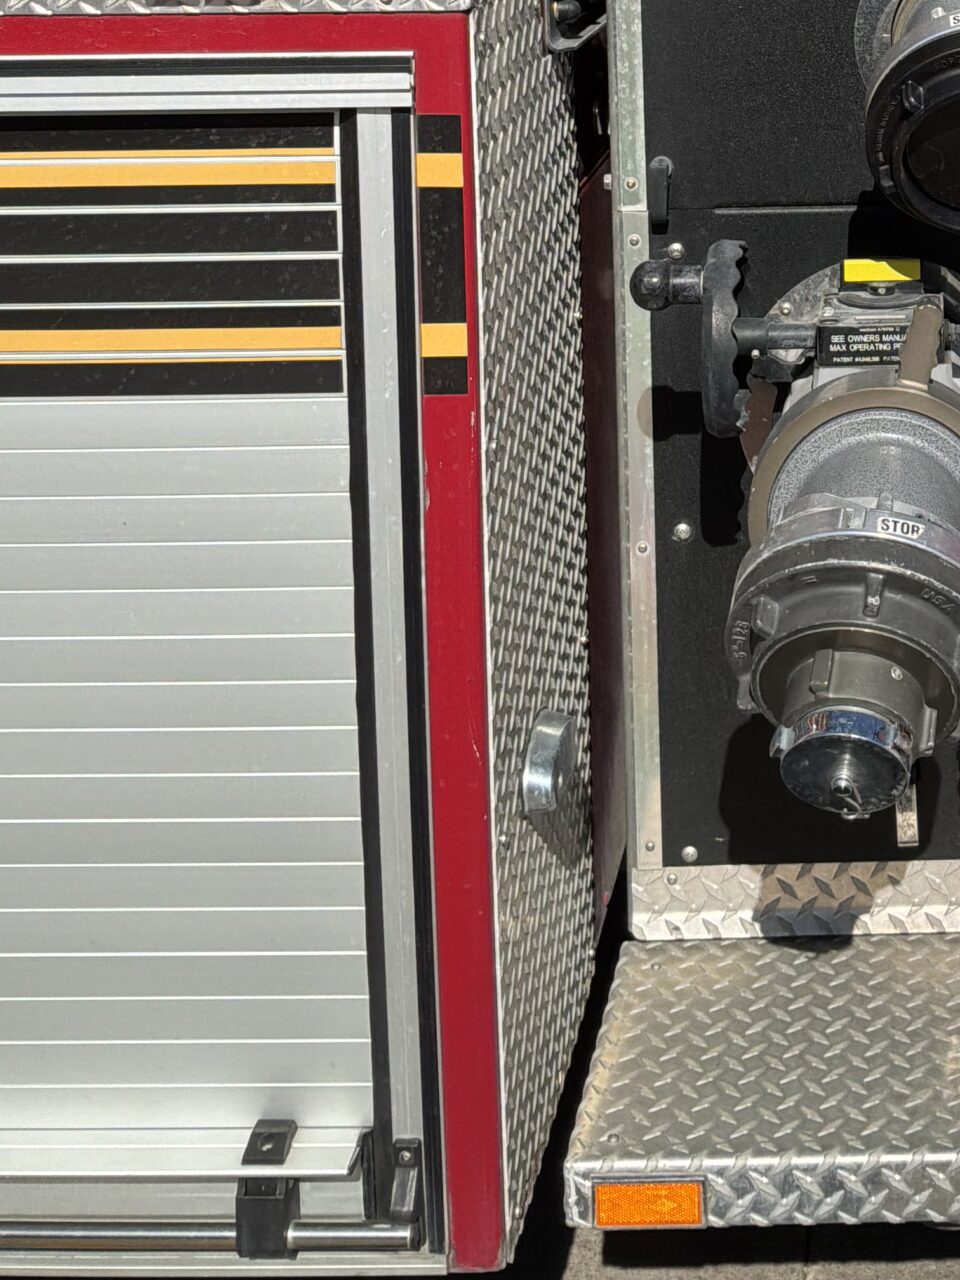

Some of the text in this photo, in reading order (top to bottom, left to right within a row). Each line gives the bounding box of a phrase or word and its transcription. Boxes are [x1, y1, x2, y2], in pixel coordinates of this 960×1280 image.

[830, 335, 846, 343] SEE
[847, 334, 880, 342] OWNERS
[829, 344, 847, 352] MAX
[849, 343, 891, 351] OPERATING
